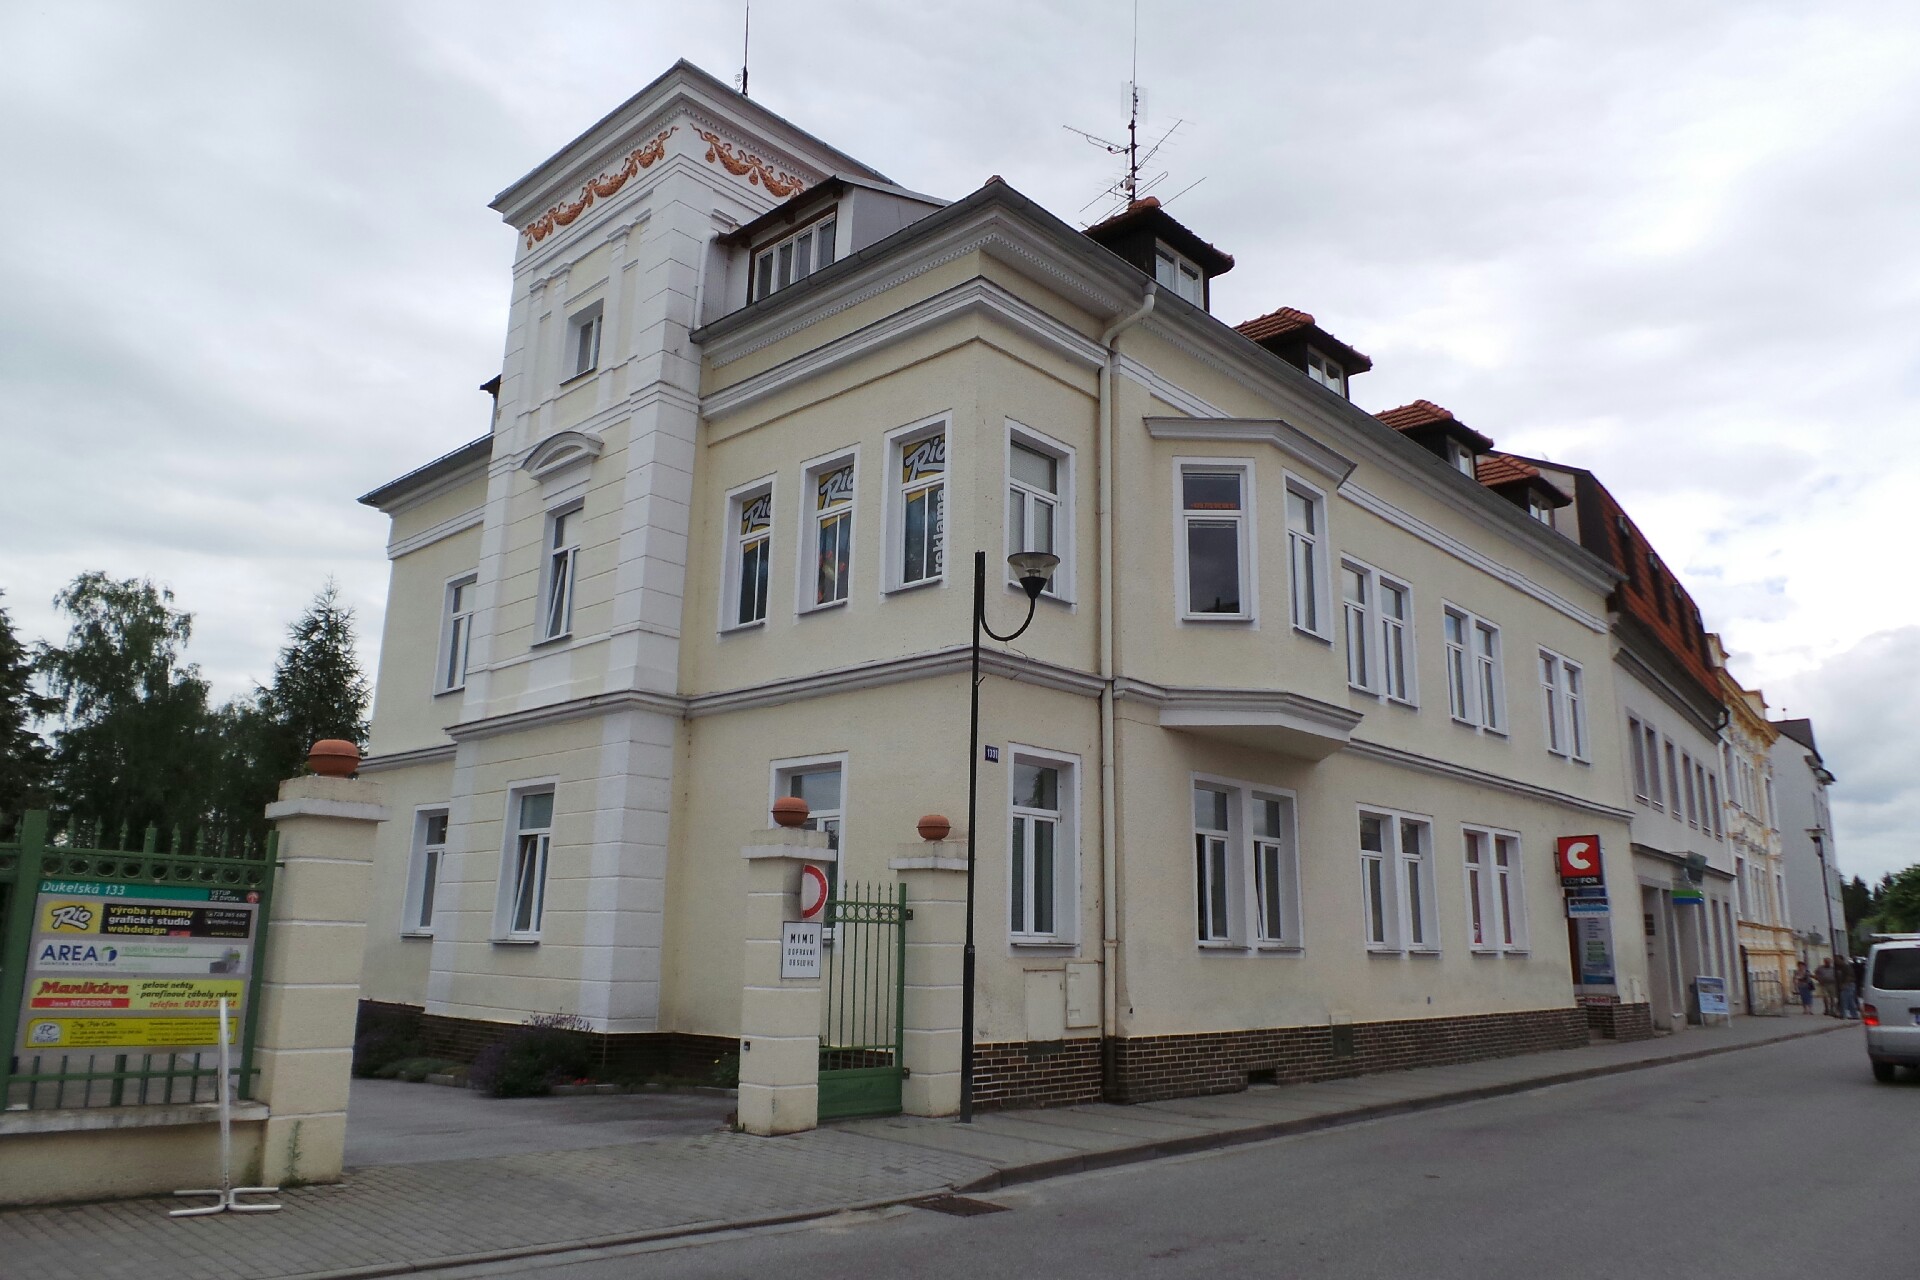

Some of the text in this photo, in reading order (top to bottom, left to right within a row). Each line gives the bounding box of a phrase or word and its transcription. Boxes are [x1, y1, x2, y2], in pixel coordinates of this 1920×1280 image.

[933, 489, 945, 575] reklama
[1567, 842, 1591, 870] C
[41, 881, 125, 896] Dukelská 133
[52, 905, 92, 930] Rio
[110, 905, 194, 919] výroba reklamy
[108, 915, 191, 926] grafické studio
[107, 925, 167, 936] webdesign
[790, 933, 814, 944] MIMO
[40, 944, 98, 961] AREA
[37, 981, 129, 996] Manikúra
[141, 981, 194, 990] gelové nehty
